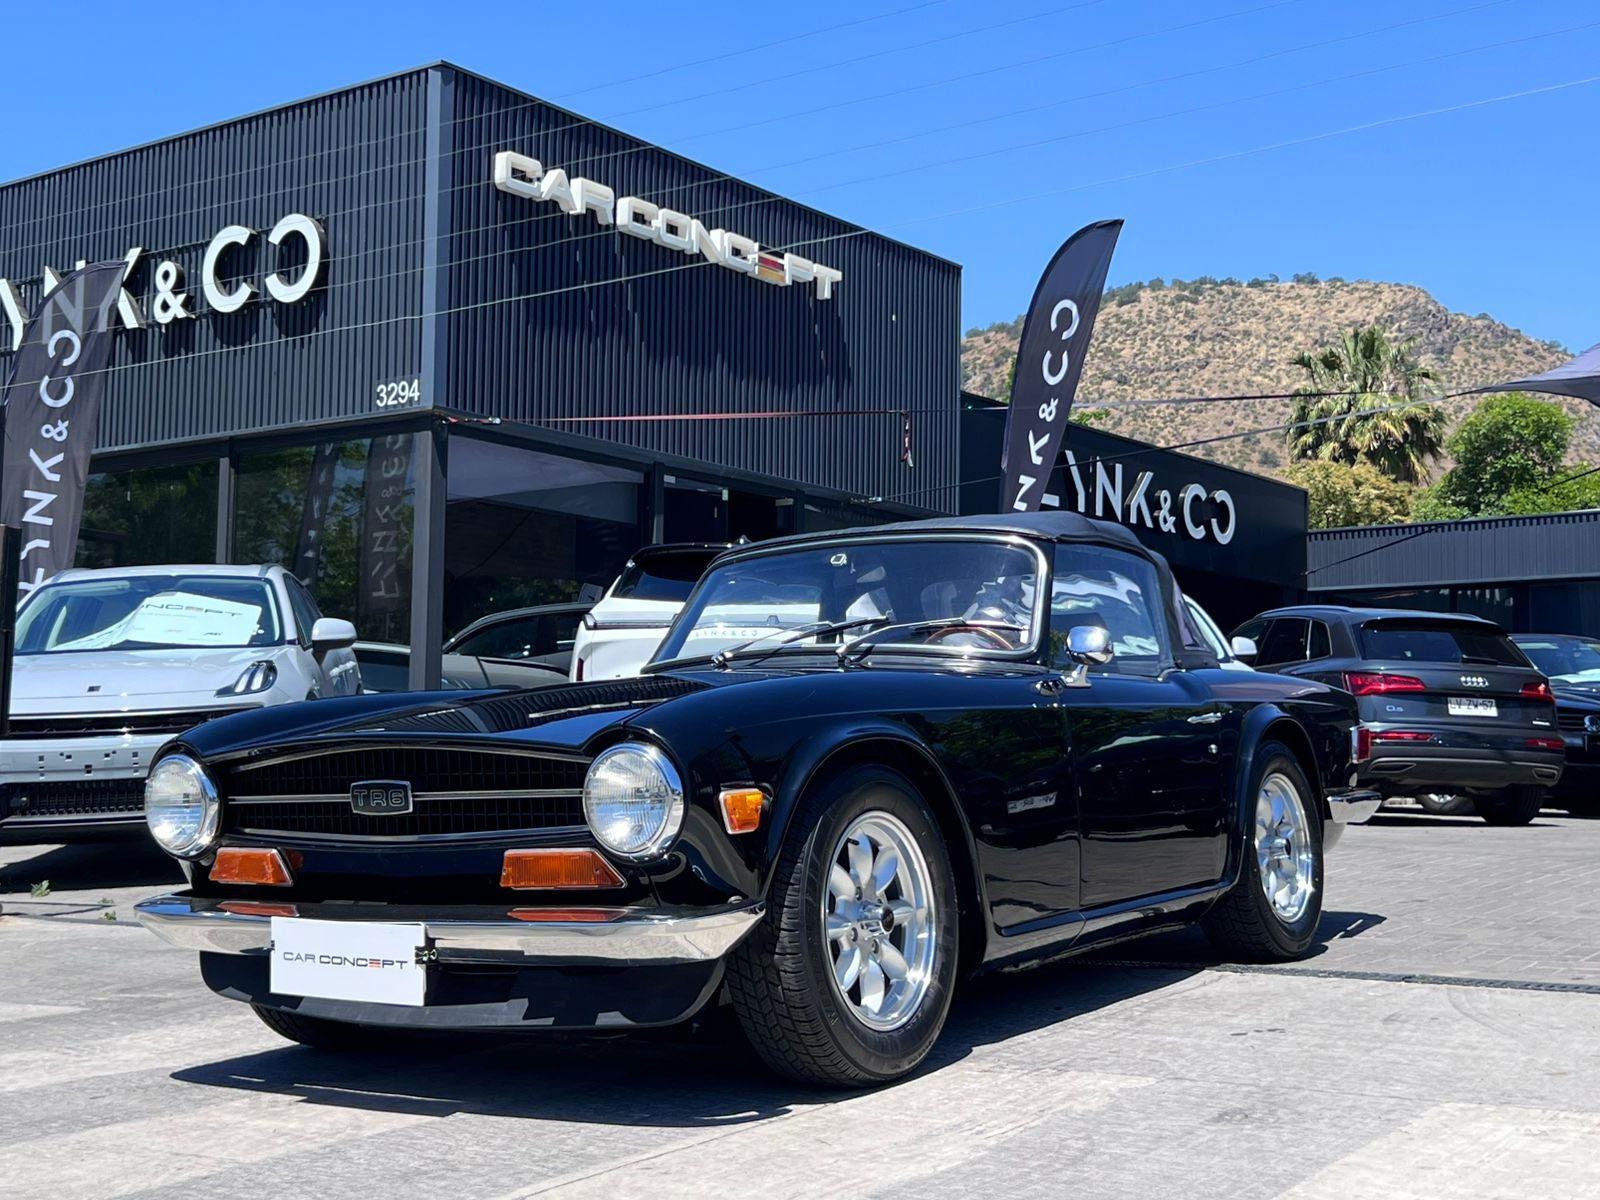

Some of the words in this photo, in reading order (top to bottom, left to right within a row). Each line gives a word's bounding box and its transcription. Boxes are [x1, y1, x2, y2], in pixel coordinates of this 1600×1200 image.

[494, 151, 615, 225] CAR
[616, 196, 843, 300] CONCEPT
[376, 379, 420, 407] 3294
[1013, 299, 1080, 512] NK&CO
[141, 603, 244, 618] NCEPT
[353, 789, 405, 807] TR6
[283, 951, 316, 963] CAR
[319, 954, 408, 970] CONCEPT
